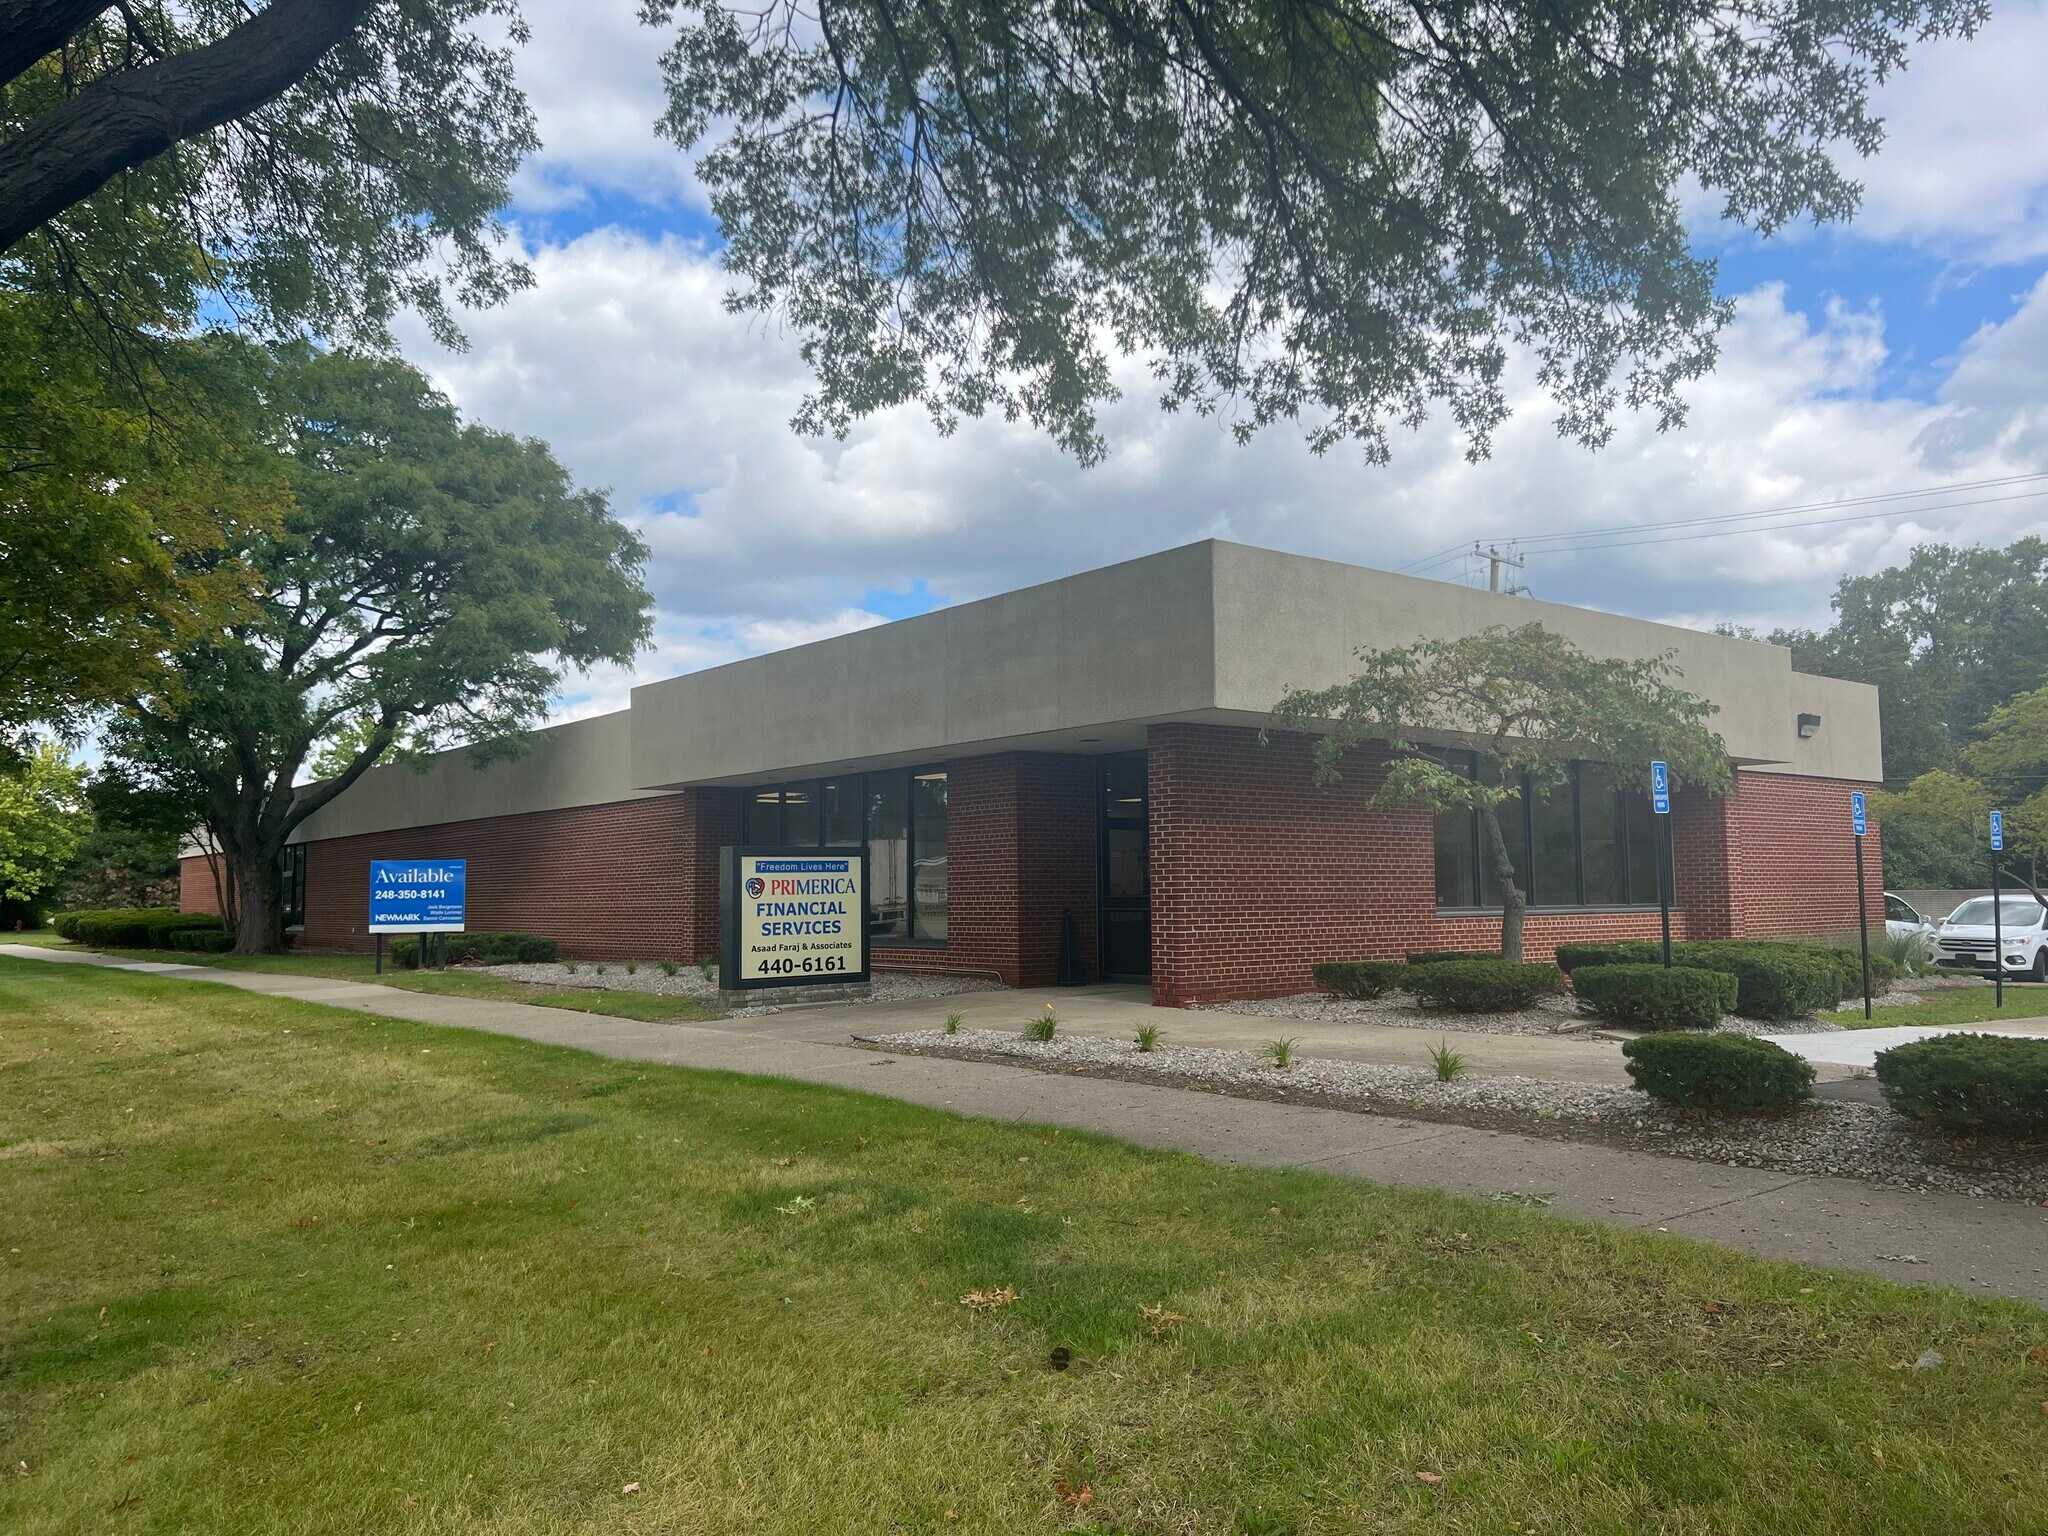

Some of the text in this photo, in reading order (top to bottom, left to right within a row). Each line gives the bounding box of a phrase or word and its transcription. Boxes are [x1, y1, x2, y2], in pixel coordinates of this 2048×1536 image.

[756, 862, 848, 871] "Freedom Lives Here"
[375, 868, 454, 883] Available
[374, 889, 445, 900] 248-350-8141
[771, 878, 856, 896] PRIMERICA
[756, 901, 847, 917] FINANCIAL
[375, 913, 420, 922] NEWMARK
[761, 920, 842, 937] SERVICES
[751, 943, 777, 953] Asaad
[779, 943, 800, 953] Faraj
[811, 941, 852, 950] Associates
[758, 955, 846, 974] 440-6161
